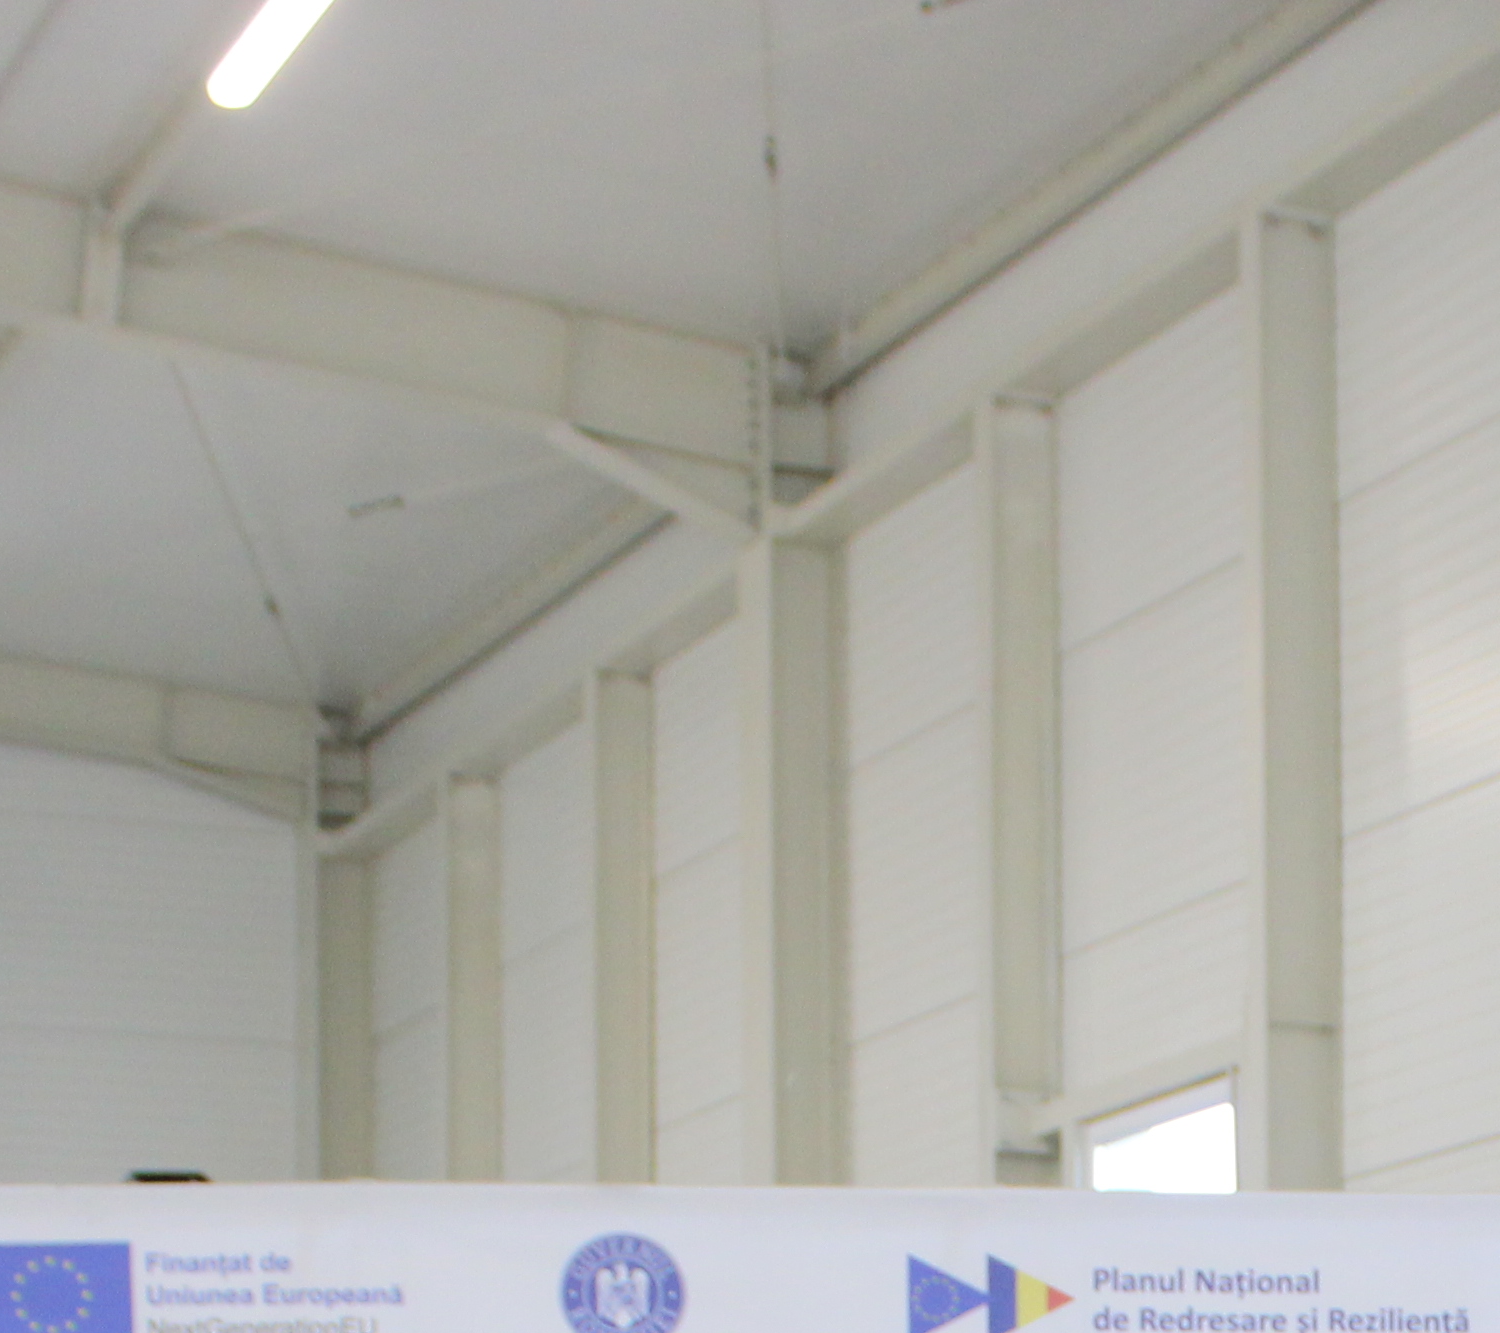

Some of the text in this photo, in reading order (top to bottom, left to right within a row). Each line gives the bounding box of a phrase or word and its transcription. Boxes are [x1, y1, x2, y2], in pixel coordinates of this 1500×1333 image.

[145, 1252, 291, 1278] Finanțat de
[145, 1283, 404, 1309] Uniunea Europeană
[1093, 1268, 1320, 1298] Planul Național
[1093, 1306, 1129, 1333] de
[1140, 1307, 1287, 1333] Redresare
